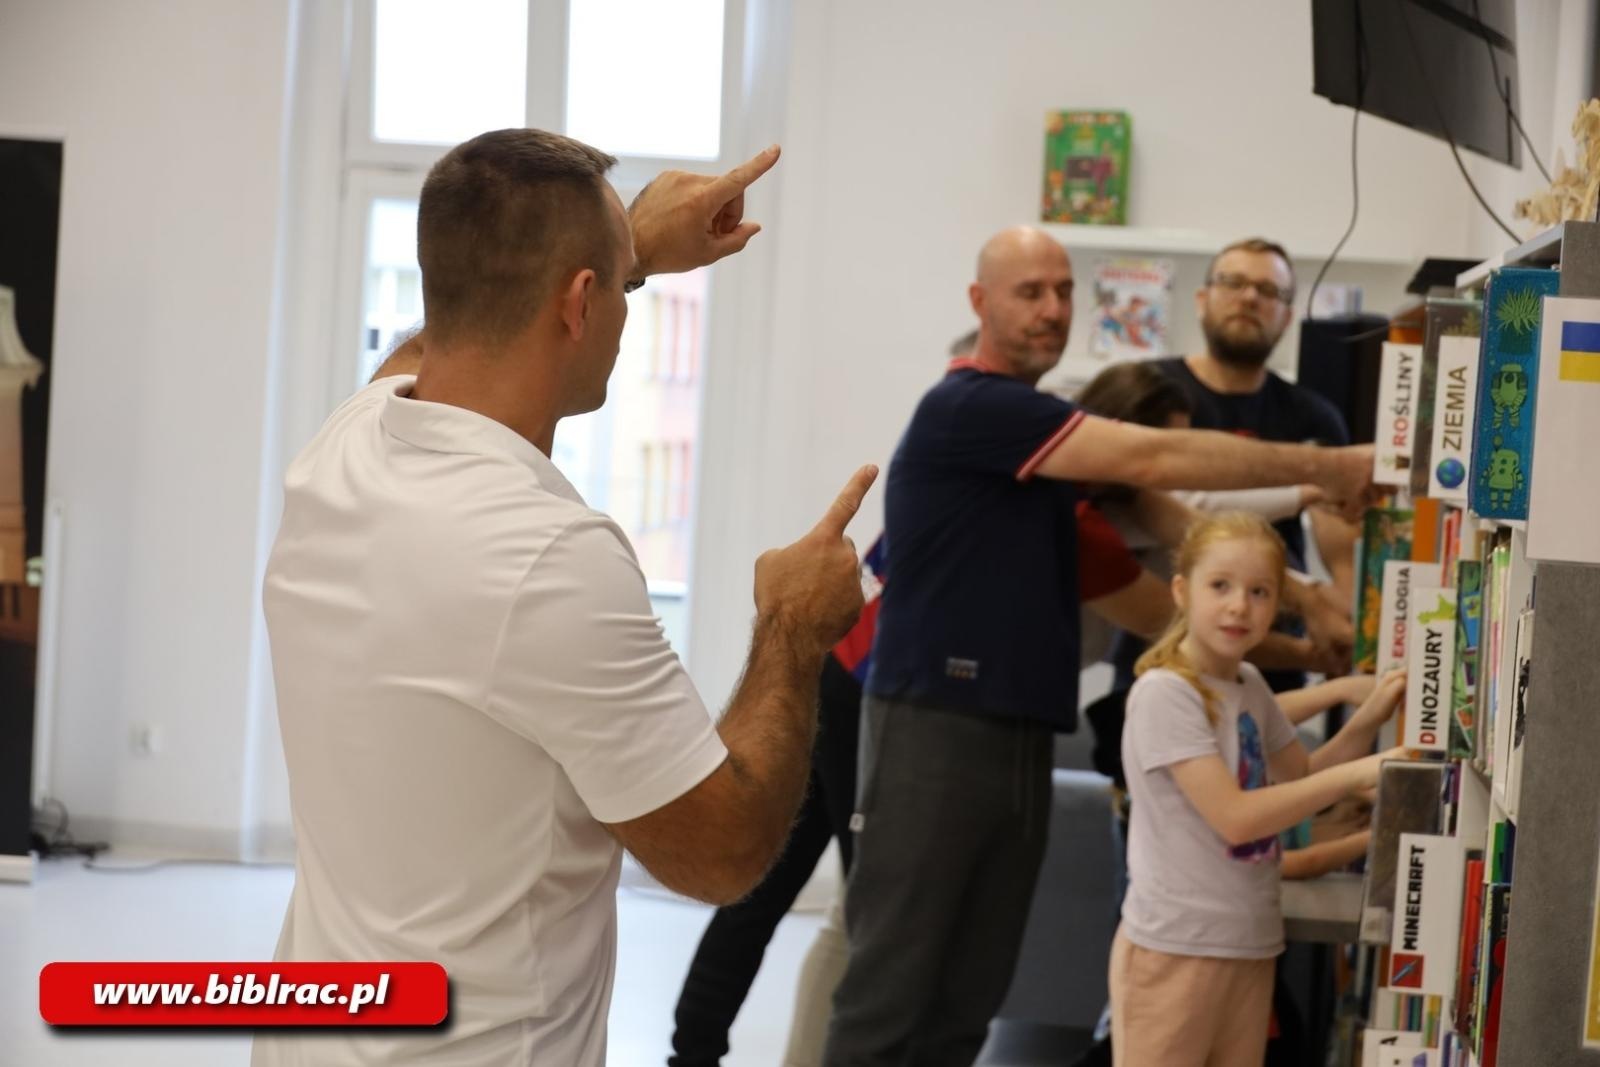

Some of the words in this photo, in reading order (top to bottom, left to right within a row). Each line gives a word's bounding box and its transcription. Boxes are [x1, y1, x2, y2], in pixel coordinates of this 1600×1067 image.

[1389, 352, 1413, 446] ROŚLINY
[1442, 366, 1467, 451] ZIEMIA
[1392, 567, 1410, 658] EKOLOGIA
[1420, 628, 1442, 744] DINOZAURY
[1403, 844, 1425, 950] MINECRAFT
